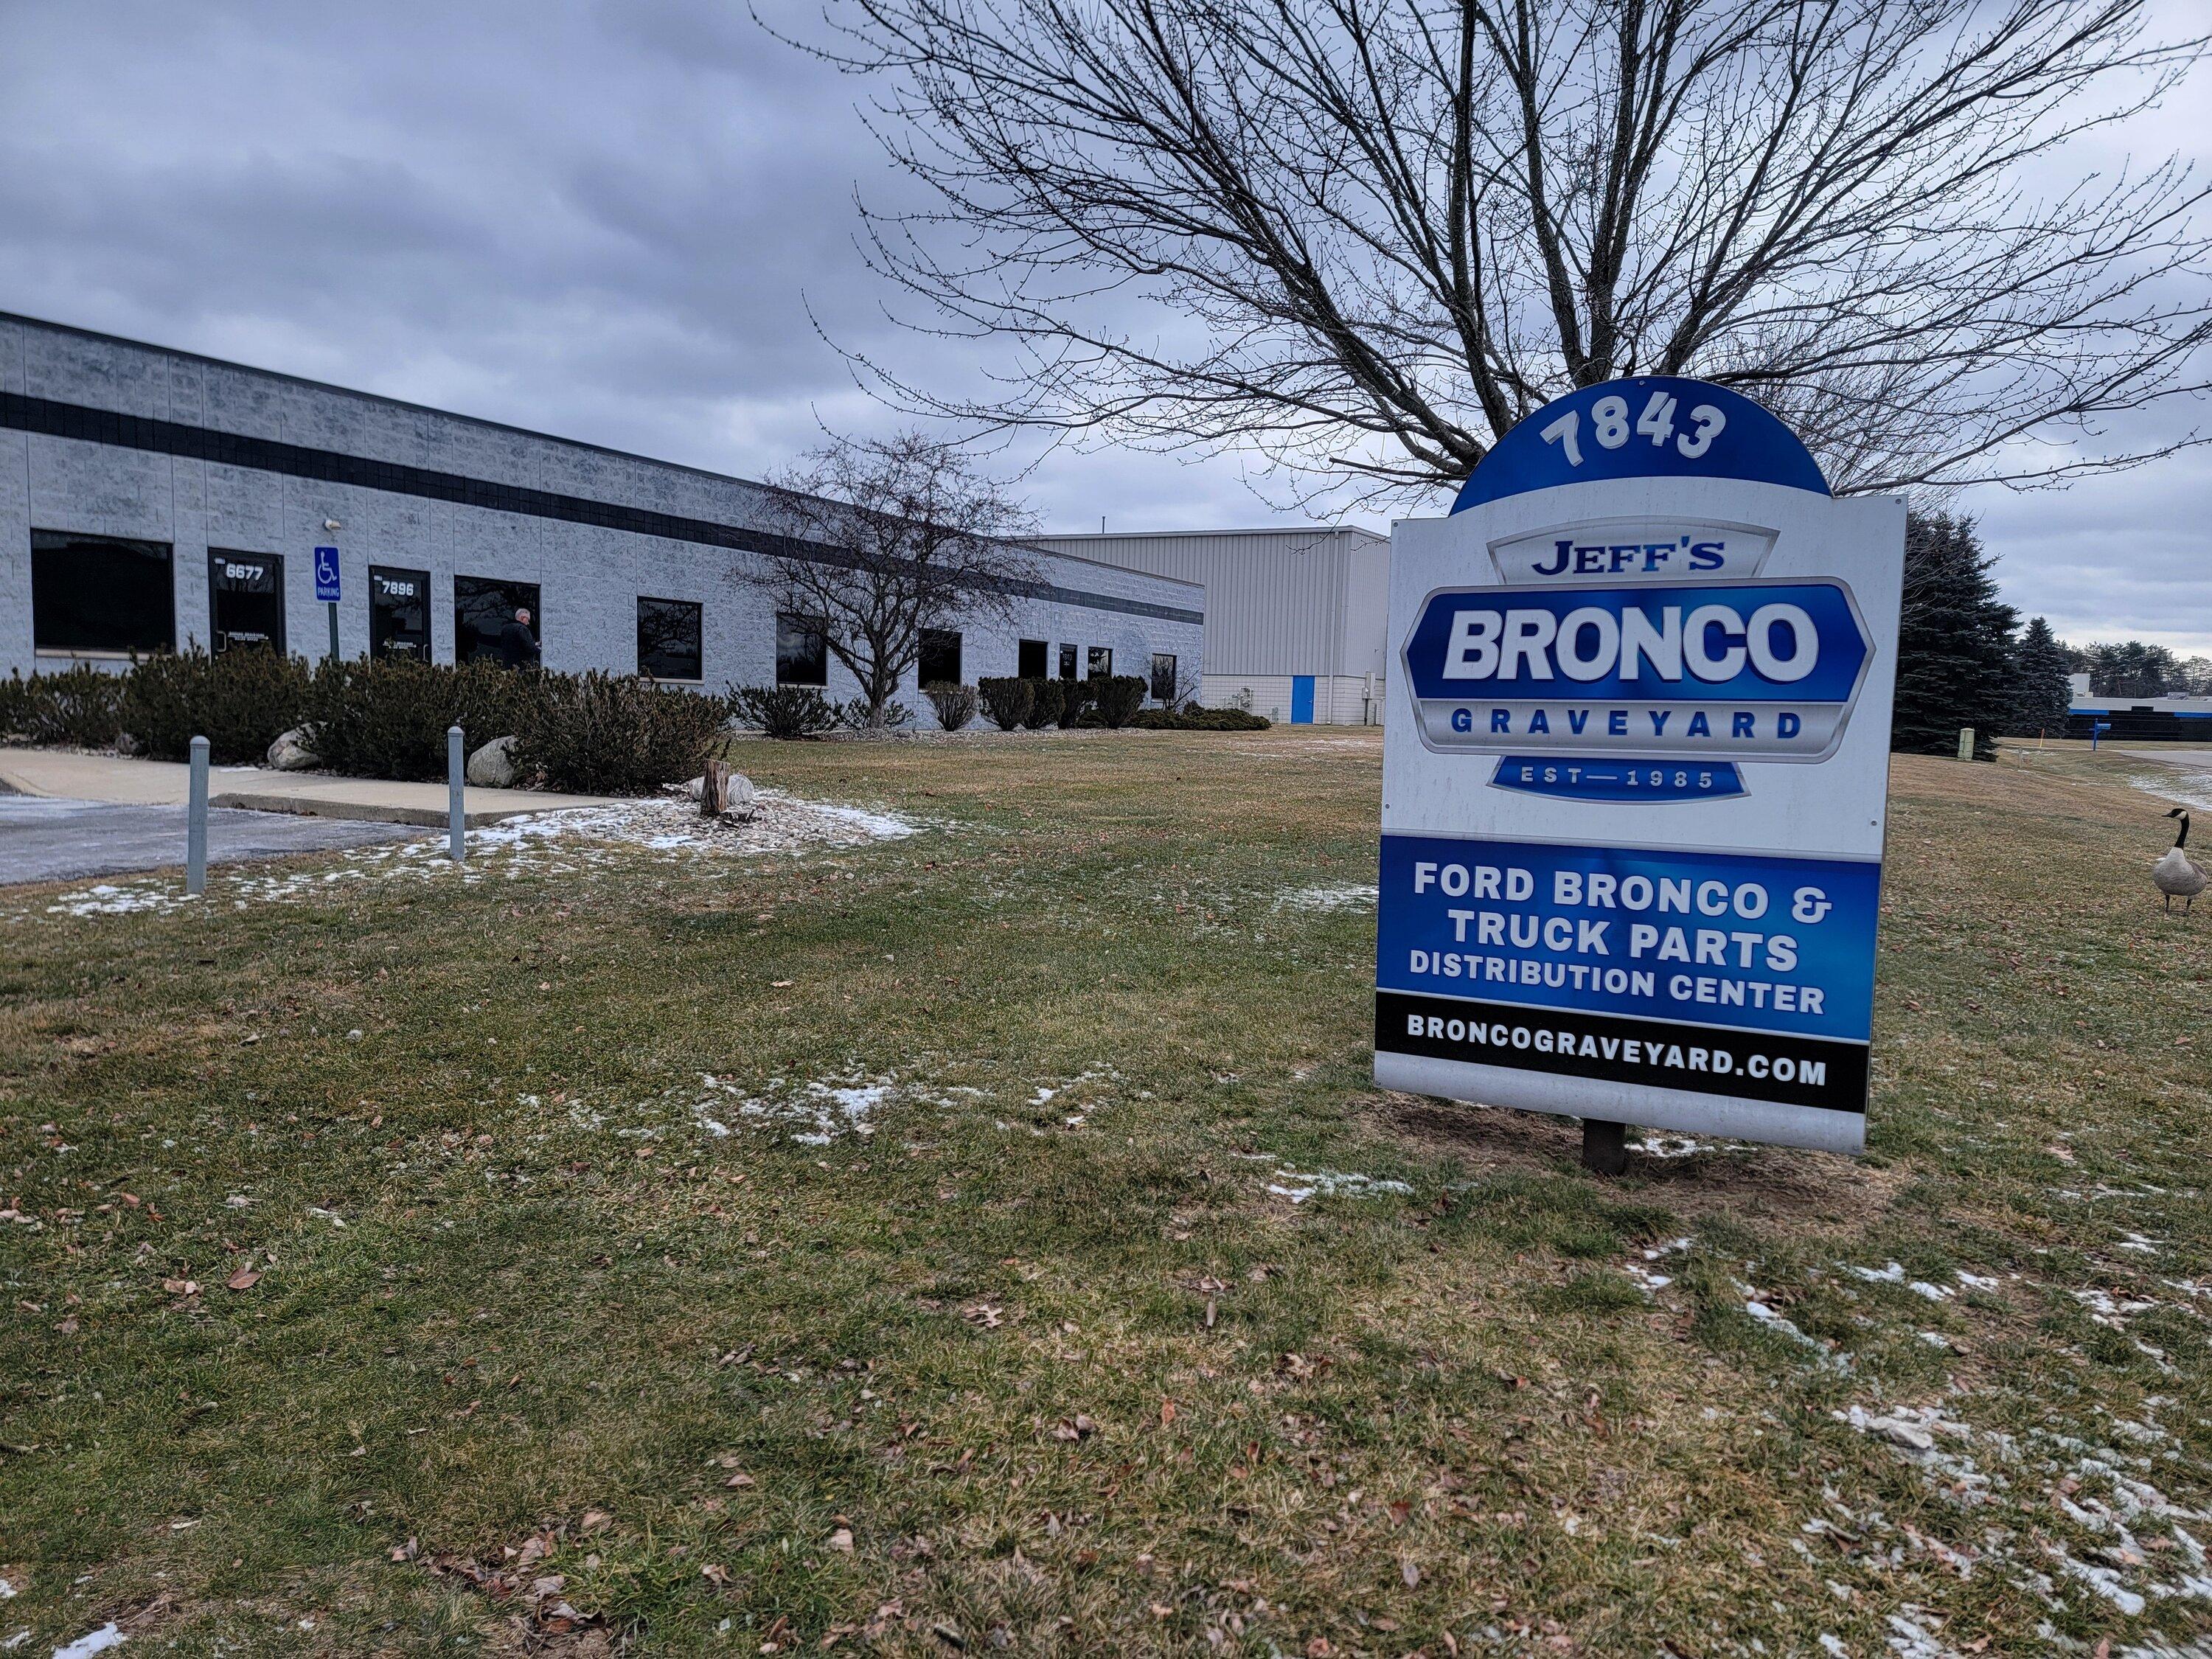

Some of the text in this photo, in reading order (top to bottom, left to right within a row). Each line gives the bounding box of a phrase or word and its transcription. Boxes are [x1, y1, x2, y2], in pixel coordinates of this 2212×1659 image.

[1540, 392, 1726, 466] 7843
[226, 563, 264, 581] 6677
[1531, 535, 1725, 575] JEFF'S
[317, 586, 340, 597] PARKING
[382, 580, 414, 597] 7896
[1443, 604, 1818, 682] BRONCO
[1452, 708, 1801, 739] GRAVEYARD
[1415, 861, 1832, 924] FORD BRONCO &
[1448, 909, 1798, 972] TRUCK PARTS
[1410, 950, 1825, 1015] DISTRIBUTION CENTER
[1408, 1015, 1826, 1085] BRONCOGRAVEYARD.COM
